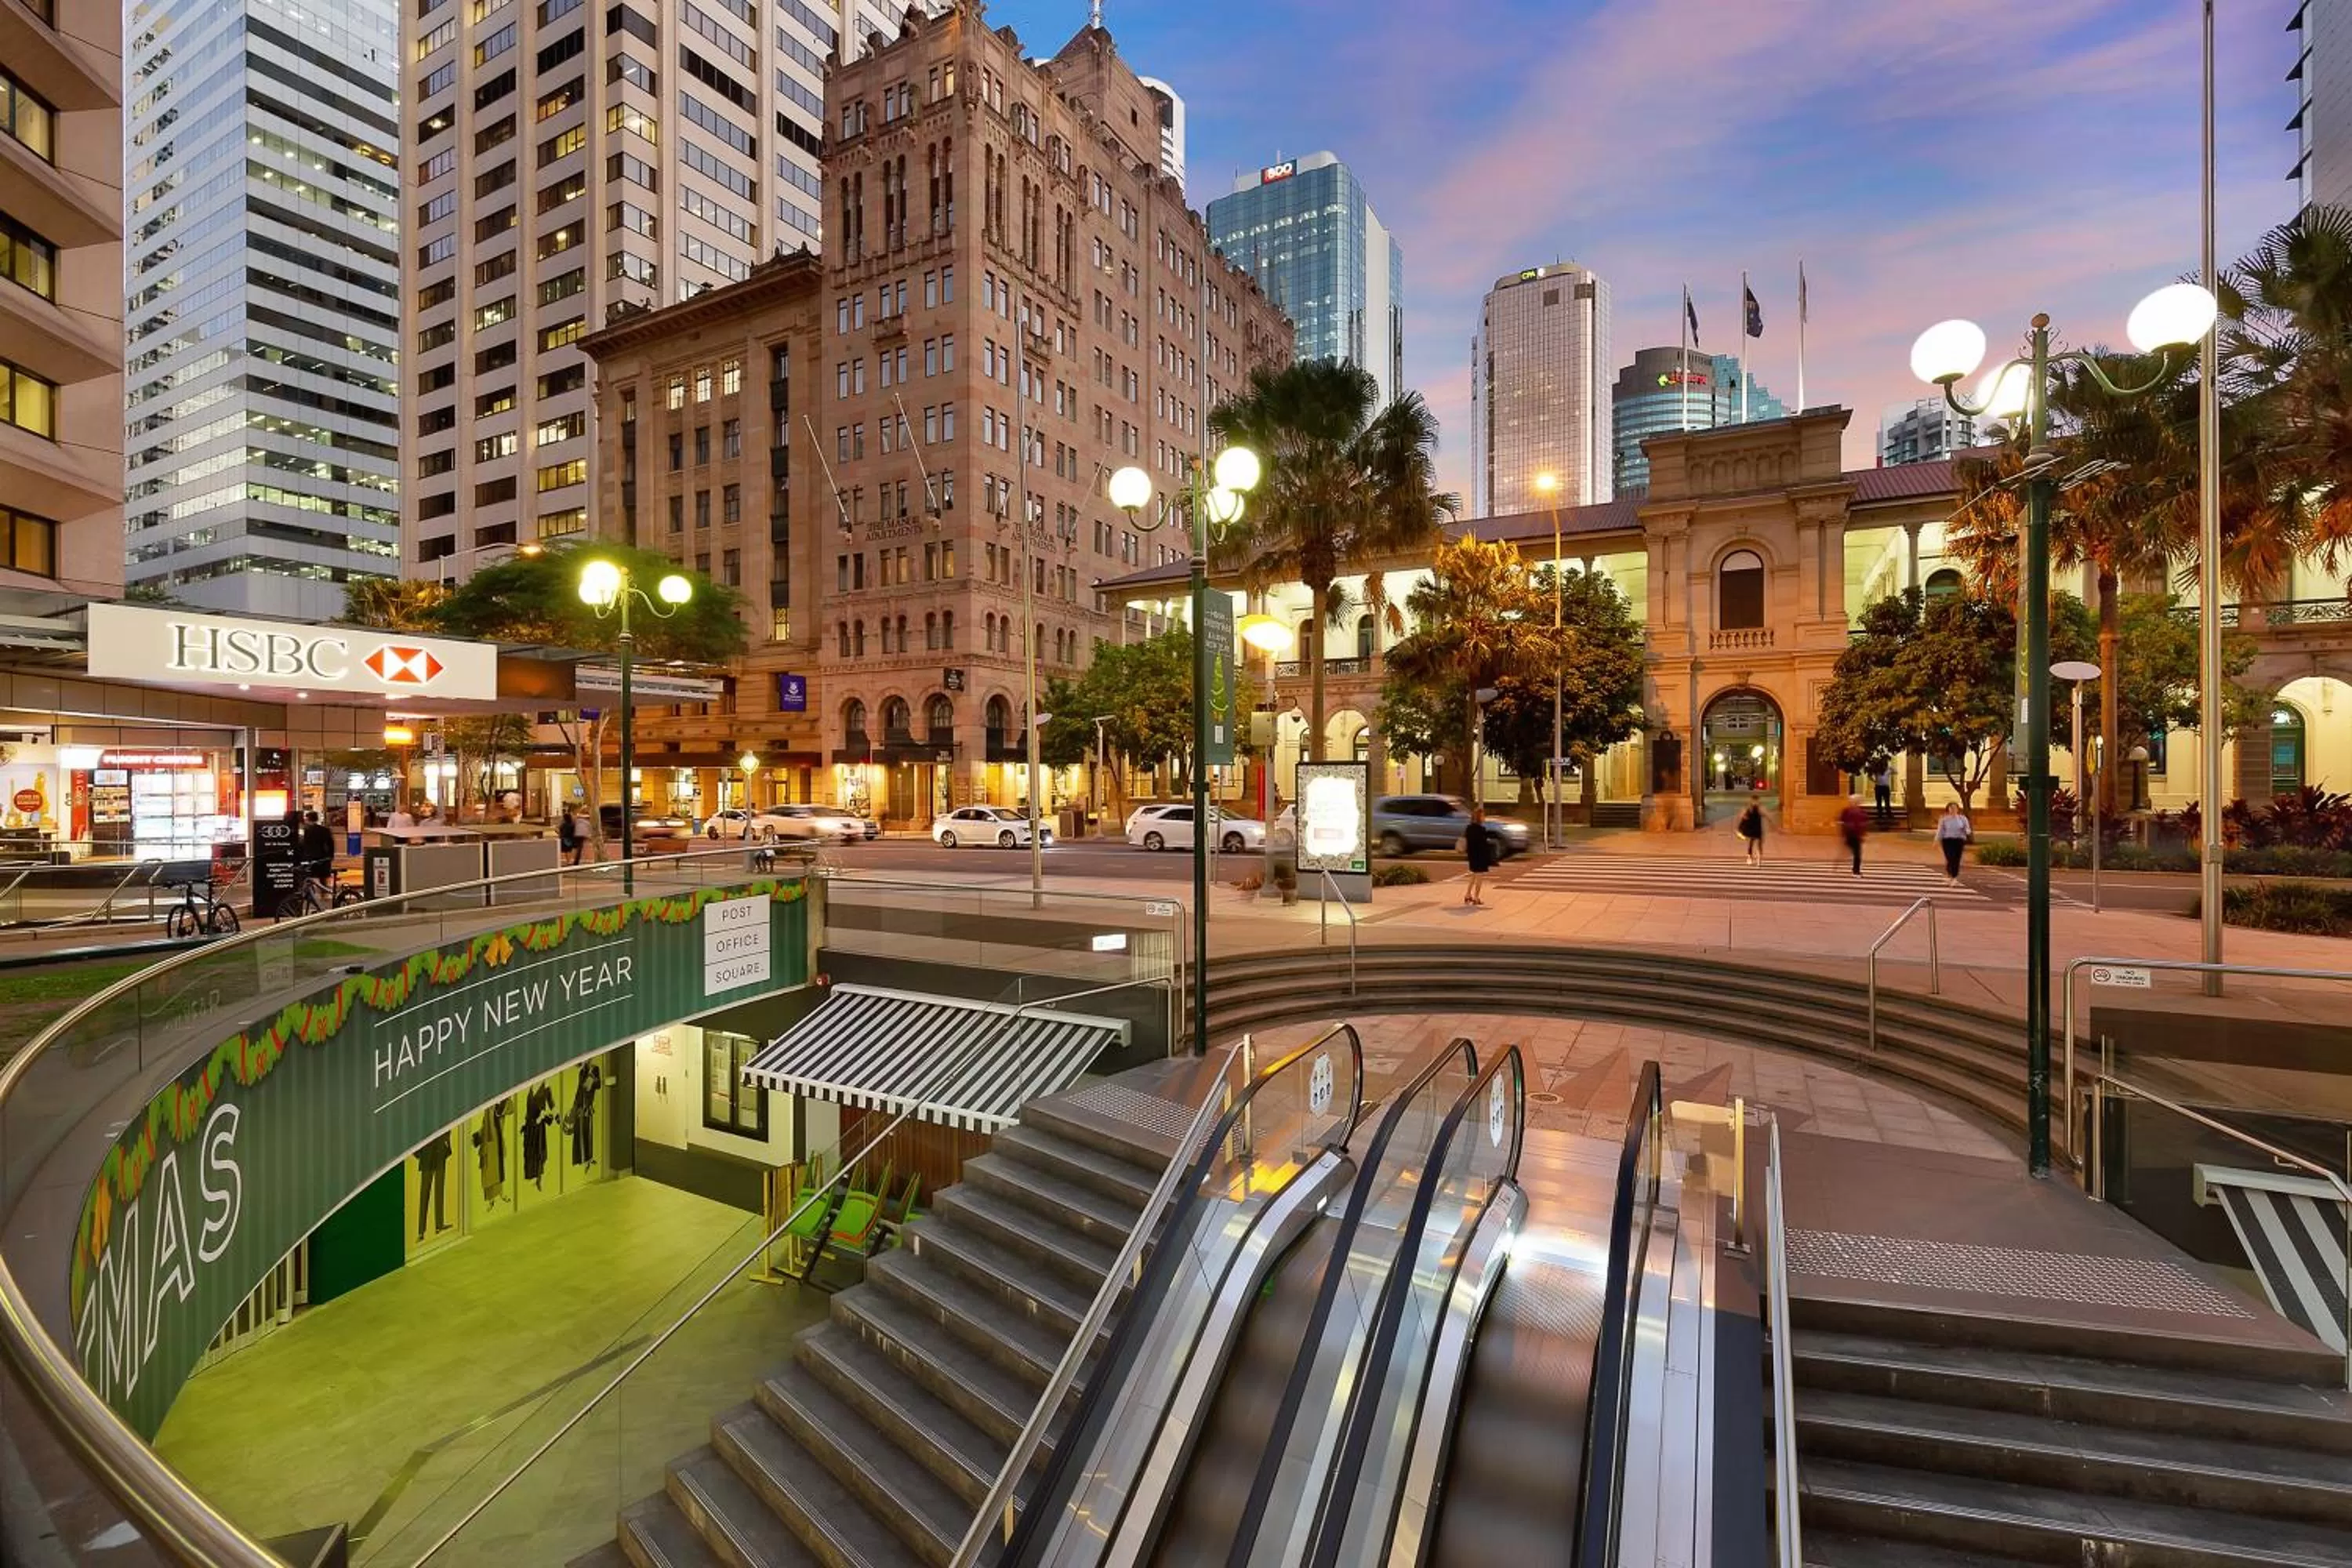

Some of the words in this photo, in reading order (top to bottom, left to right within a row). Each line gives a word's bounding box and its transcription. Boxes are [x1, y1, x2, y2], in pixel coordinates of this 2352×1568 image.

[1267, 162, 1293, 180] BDO
[166, 623, 349, 680] HSBC
[722, 906, 752, 922] POST
[716, 934, 759, 953] OFFICE
[715, 962, 764, 984] SQUARE.
[374, 1006, 472, 1088] HAPPY
[484, 979, 549, 1033] NEW
[560, 956, 633, 1001] YEAR
